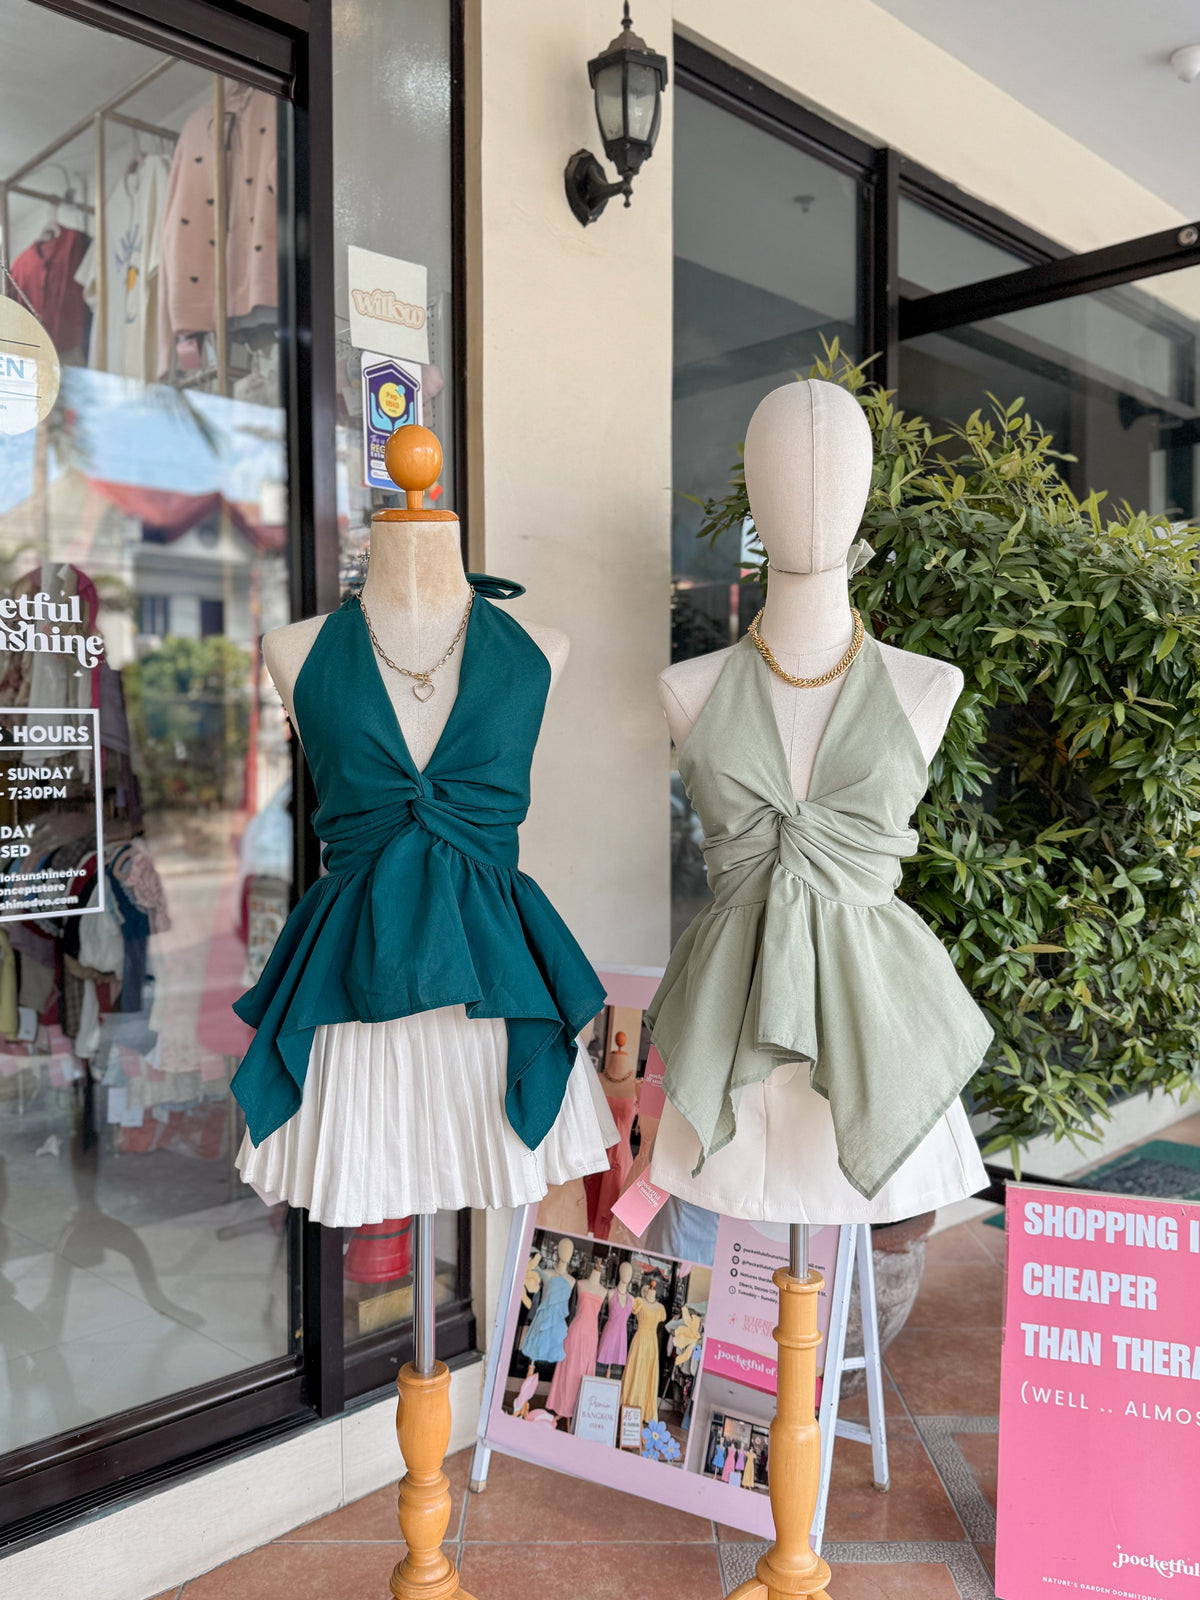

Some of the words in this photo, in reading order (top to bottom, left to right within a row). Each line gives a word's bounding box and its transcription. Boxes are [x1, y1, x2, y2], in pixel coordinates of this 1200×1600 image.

[0, 592, 82, 623] etful
[13, 725, 90, 743] HOURS
[7, 766, 74, 781] SUNDAY
[7, 785, 67, 800] 7:30PM
[0, 823, 36, 839] DAY
[1023, 1201, 1178, 1251] SHOPPING
[1022, 1262, 1157, 1311] CHEAPER
[1020, 1322, 1102, 1366] THAN
[1020, 1380, 1089, 1410] (WELL
[1112, 1552, 1200, 1579] pocketful
[1042, 1576, 1078, 1588] NATURE'S
[1080, 1583, 1111, 1595] GARDEN
